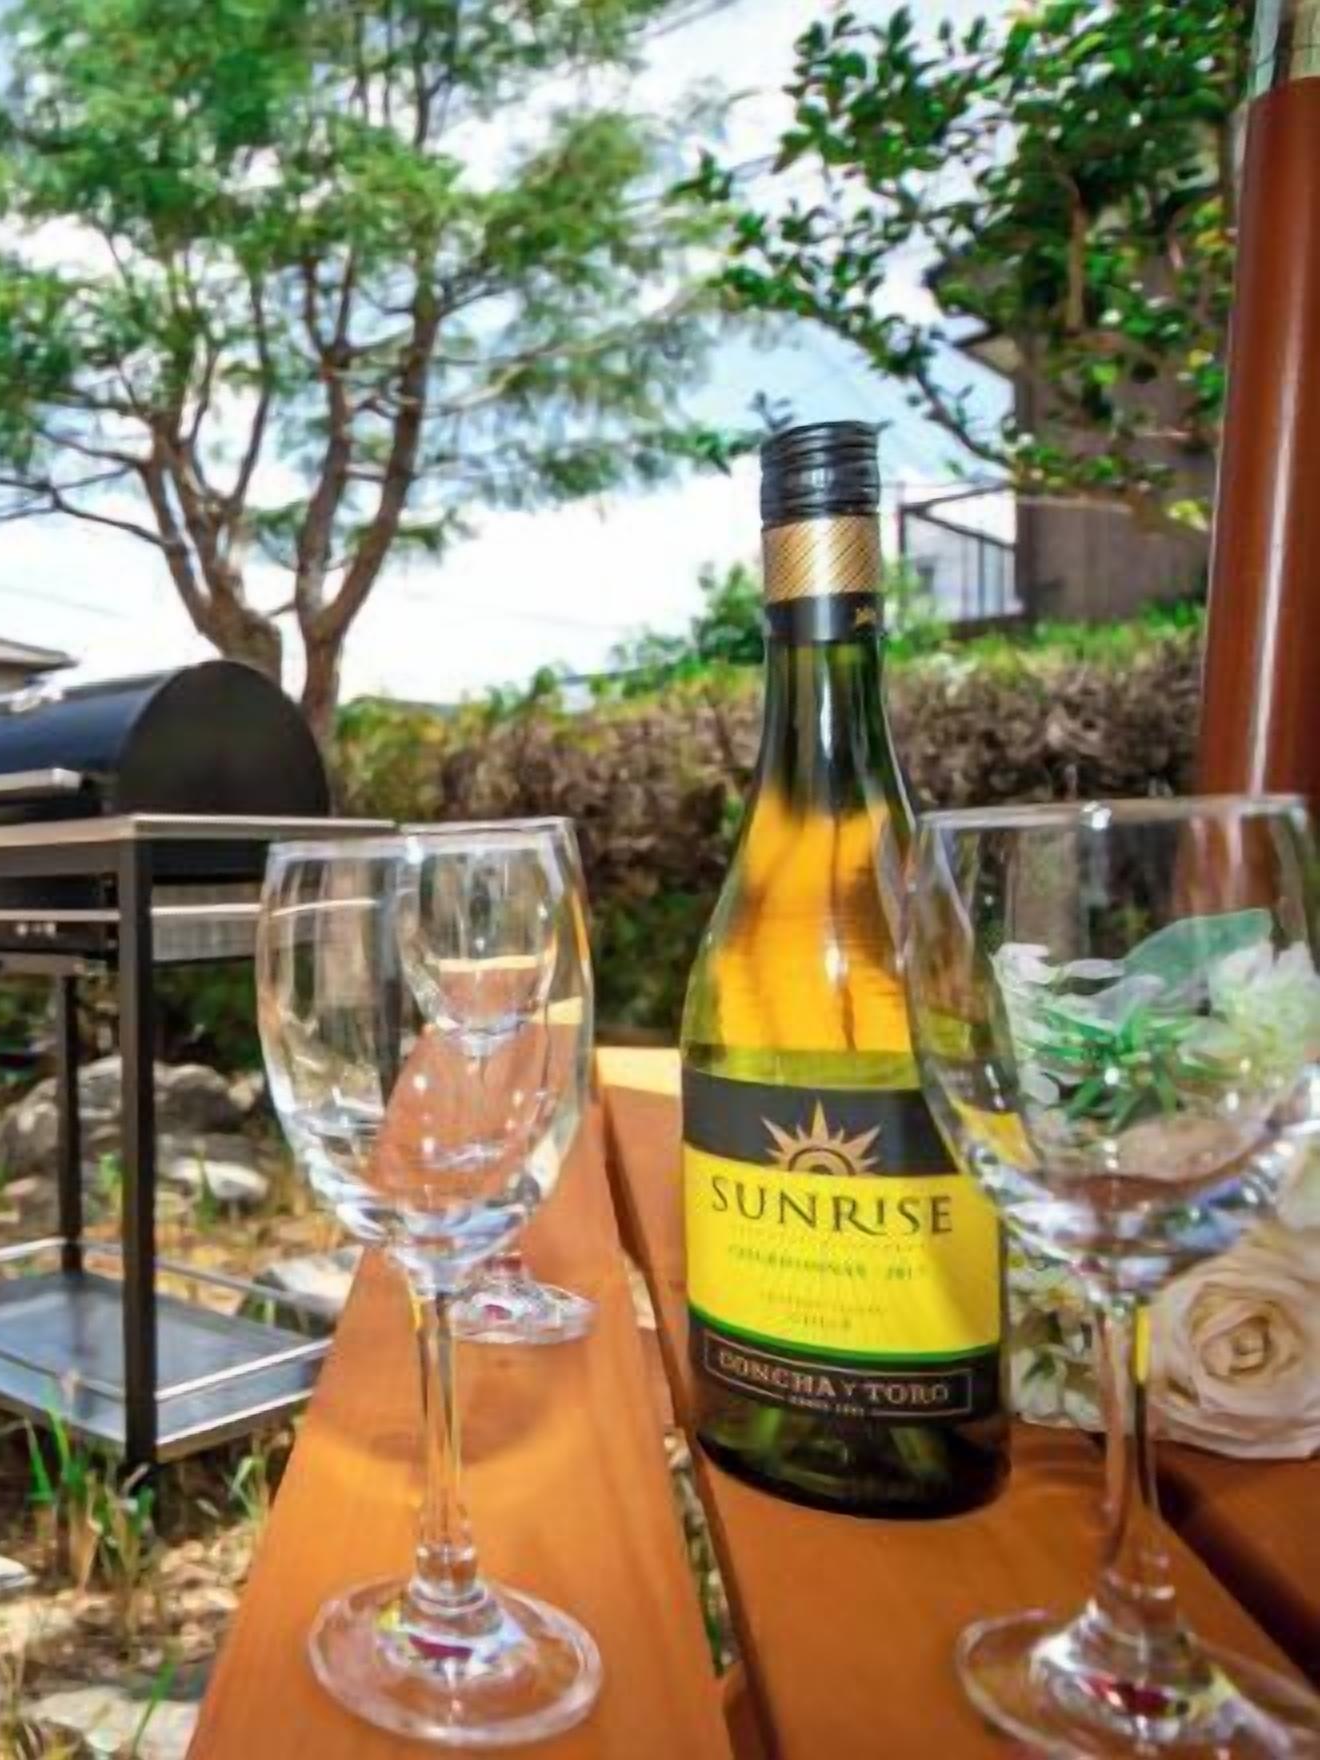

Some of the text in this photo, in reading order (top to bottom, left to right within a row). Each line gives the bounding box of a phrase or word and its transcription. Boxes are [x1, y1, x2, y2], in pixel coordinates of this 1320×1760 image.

[711, 1176, 953, 1236] SUNRISE
[719, 1351, 837, 1397] CONCHA
[865, 1384, 949, 1404] TORO
